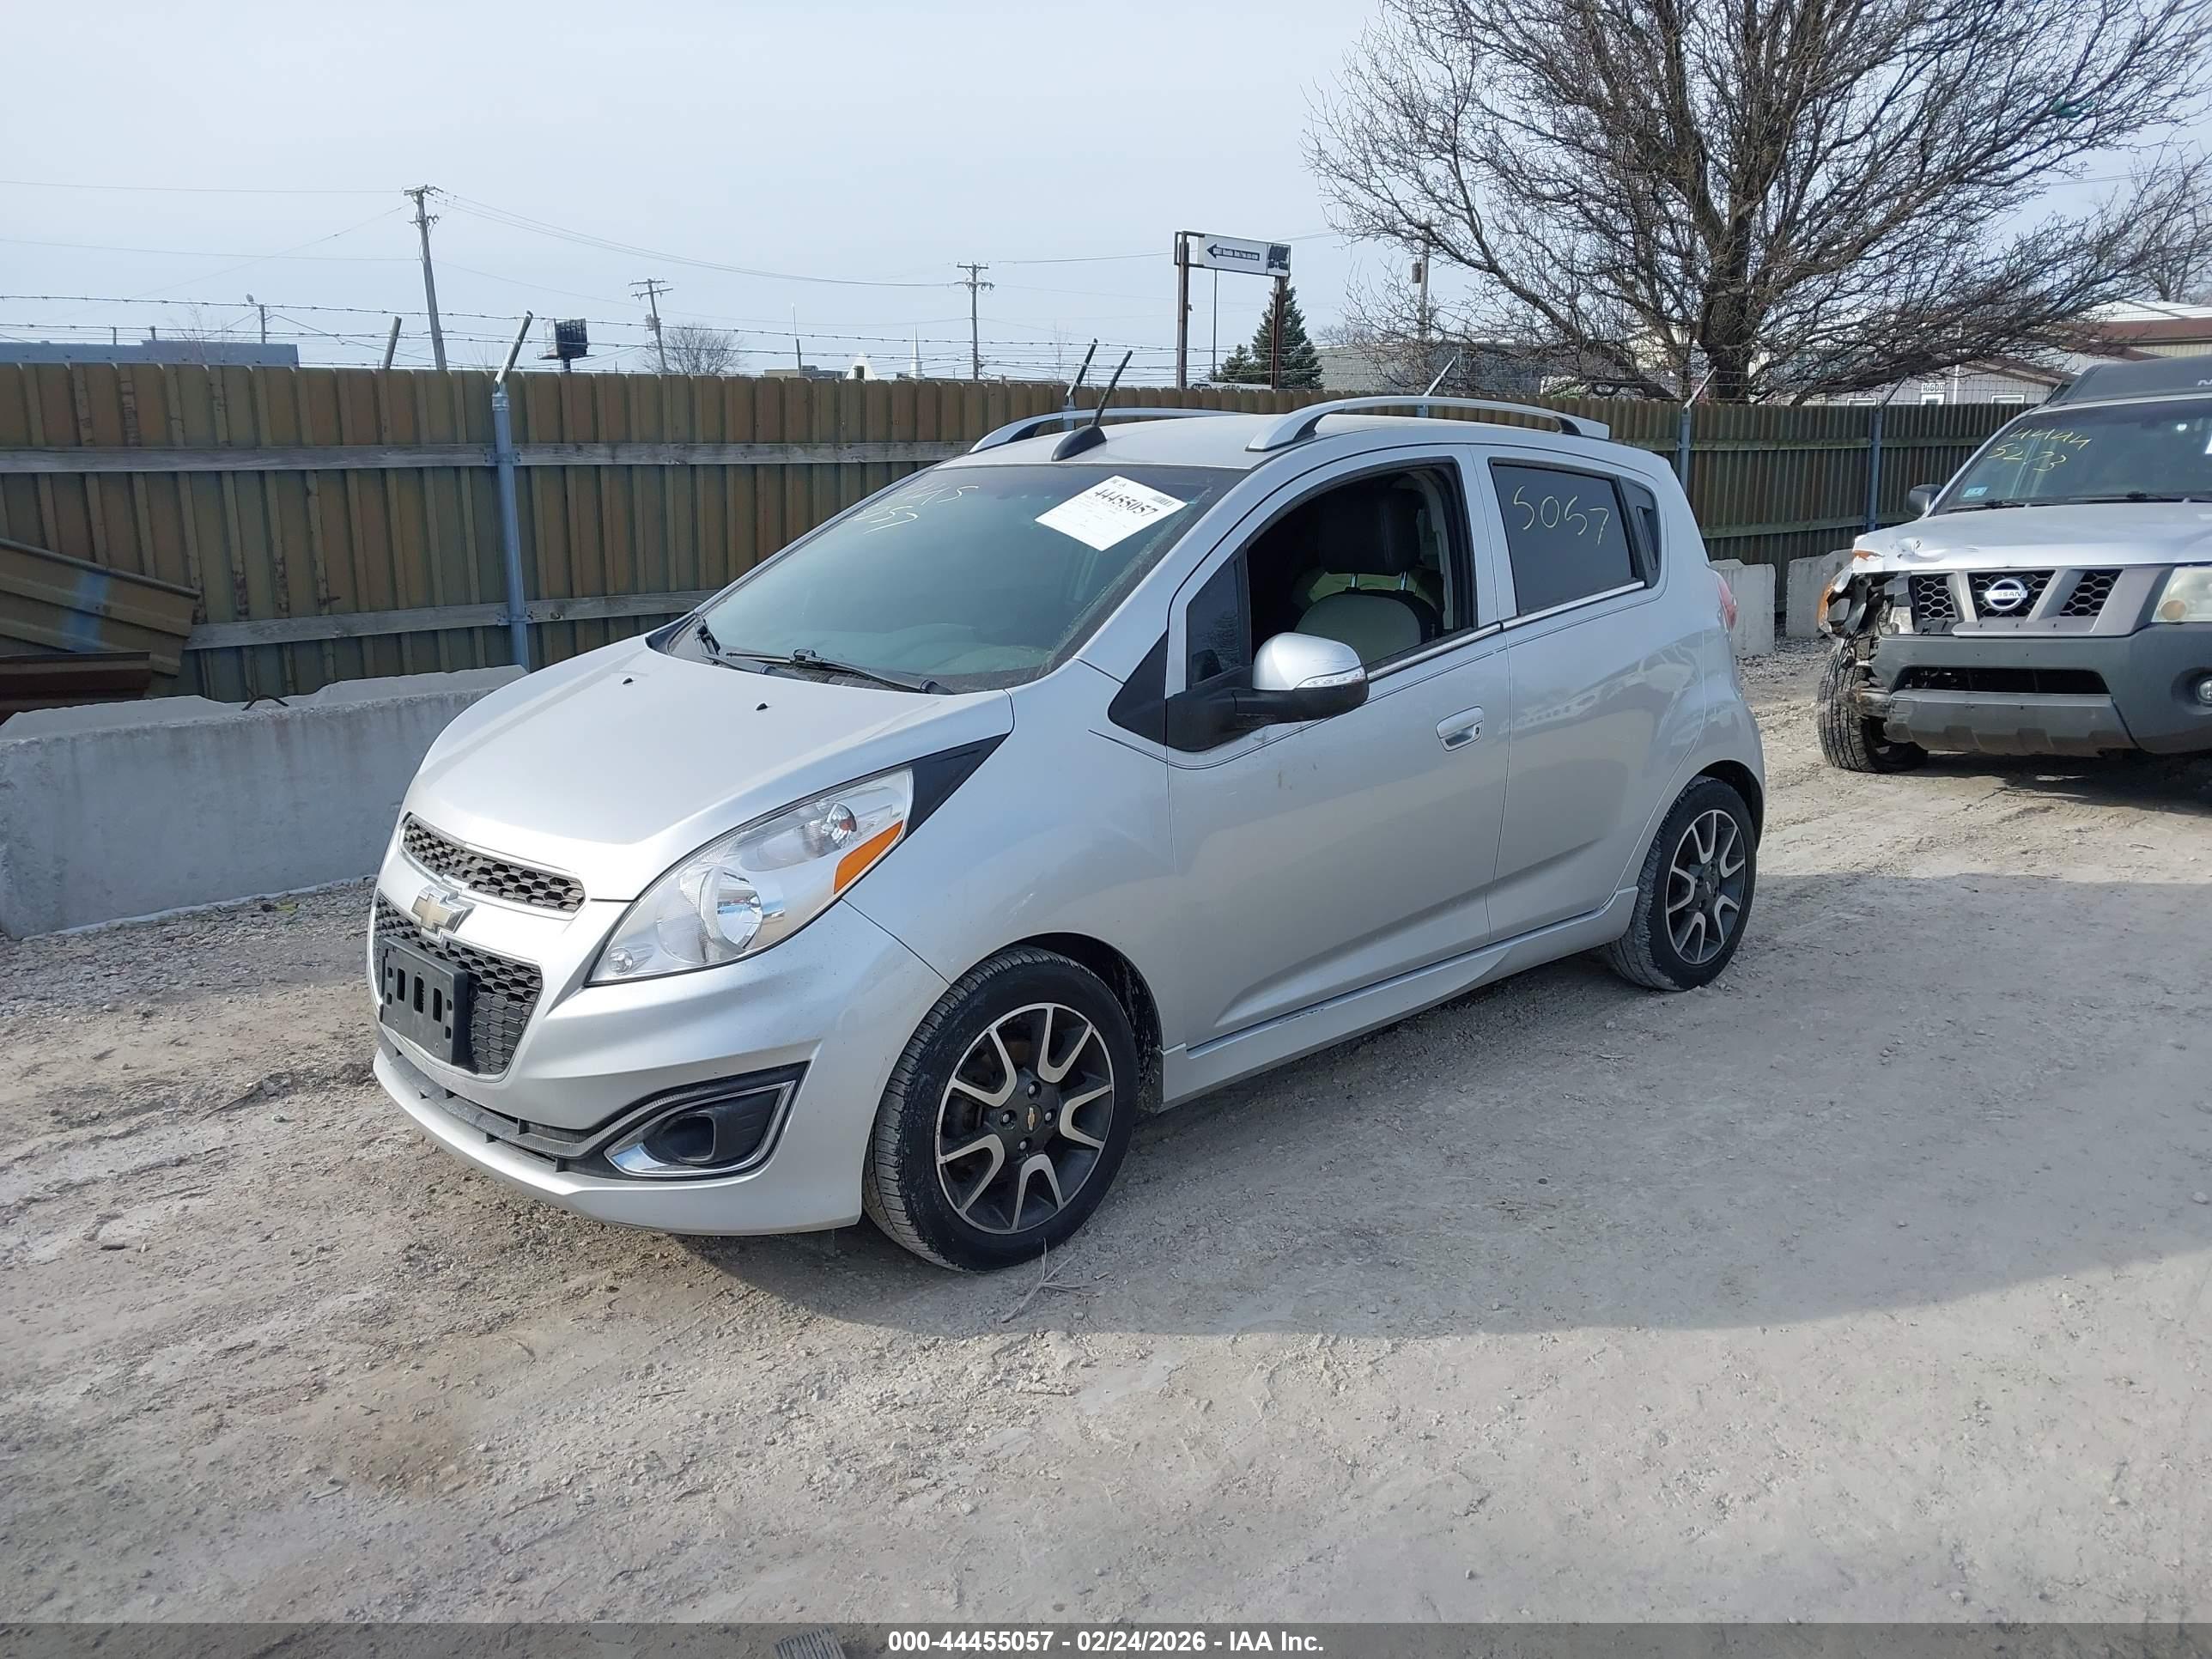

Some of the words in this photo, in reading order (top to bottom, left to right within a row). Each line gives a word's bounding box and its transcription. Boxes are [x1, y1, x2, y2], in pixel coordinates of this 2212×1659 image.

[1986, 442, 2068, 471] 5273
[898, 479, 980, 506] 45
[1095, 489, 1159, 517] 44455057
[1514, 485, 1610, 545] 5057
[1989, 590, 2021, 599] SSAN
